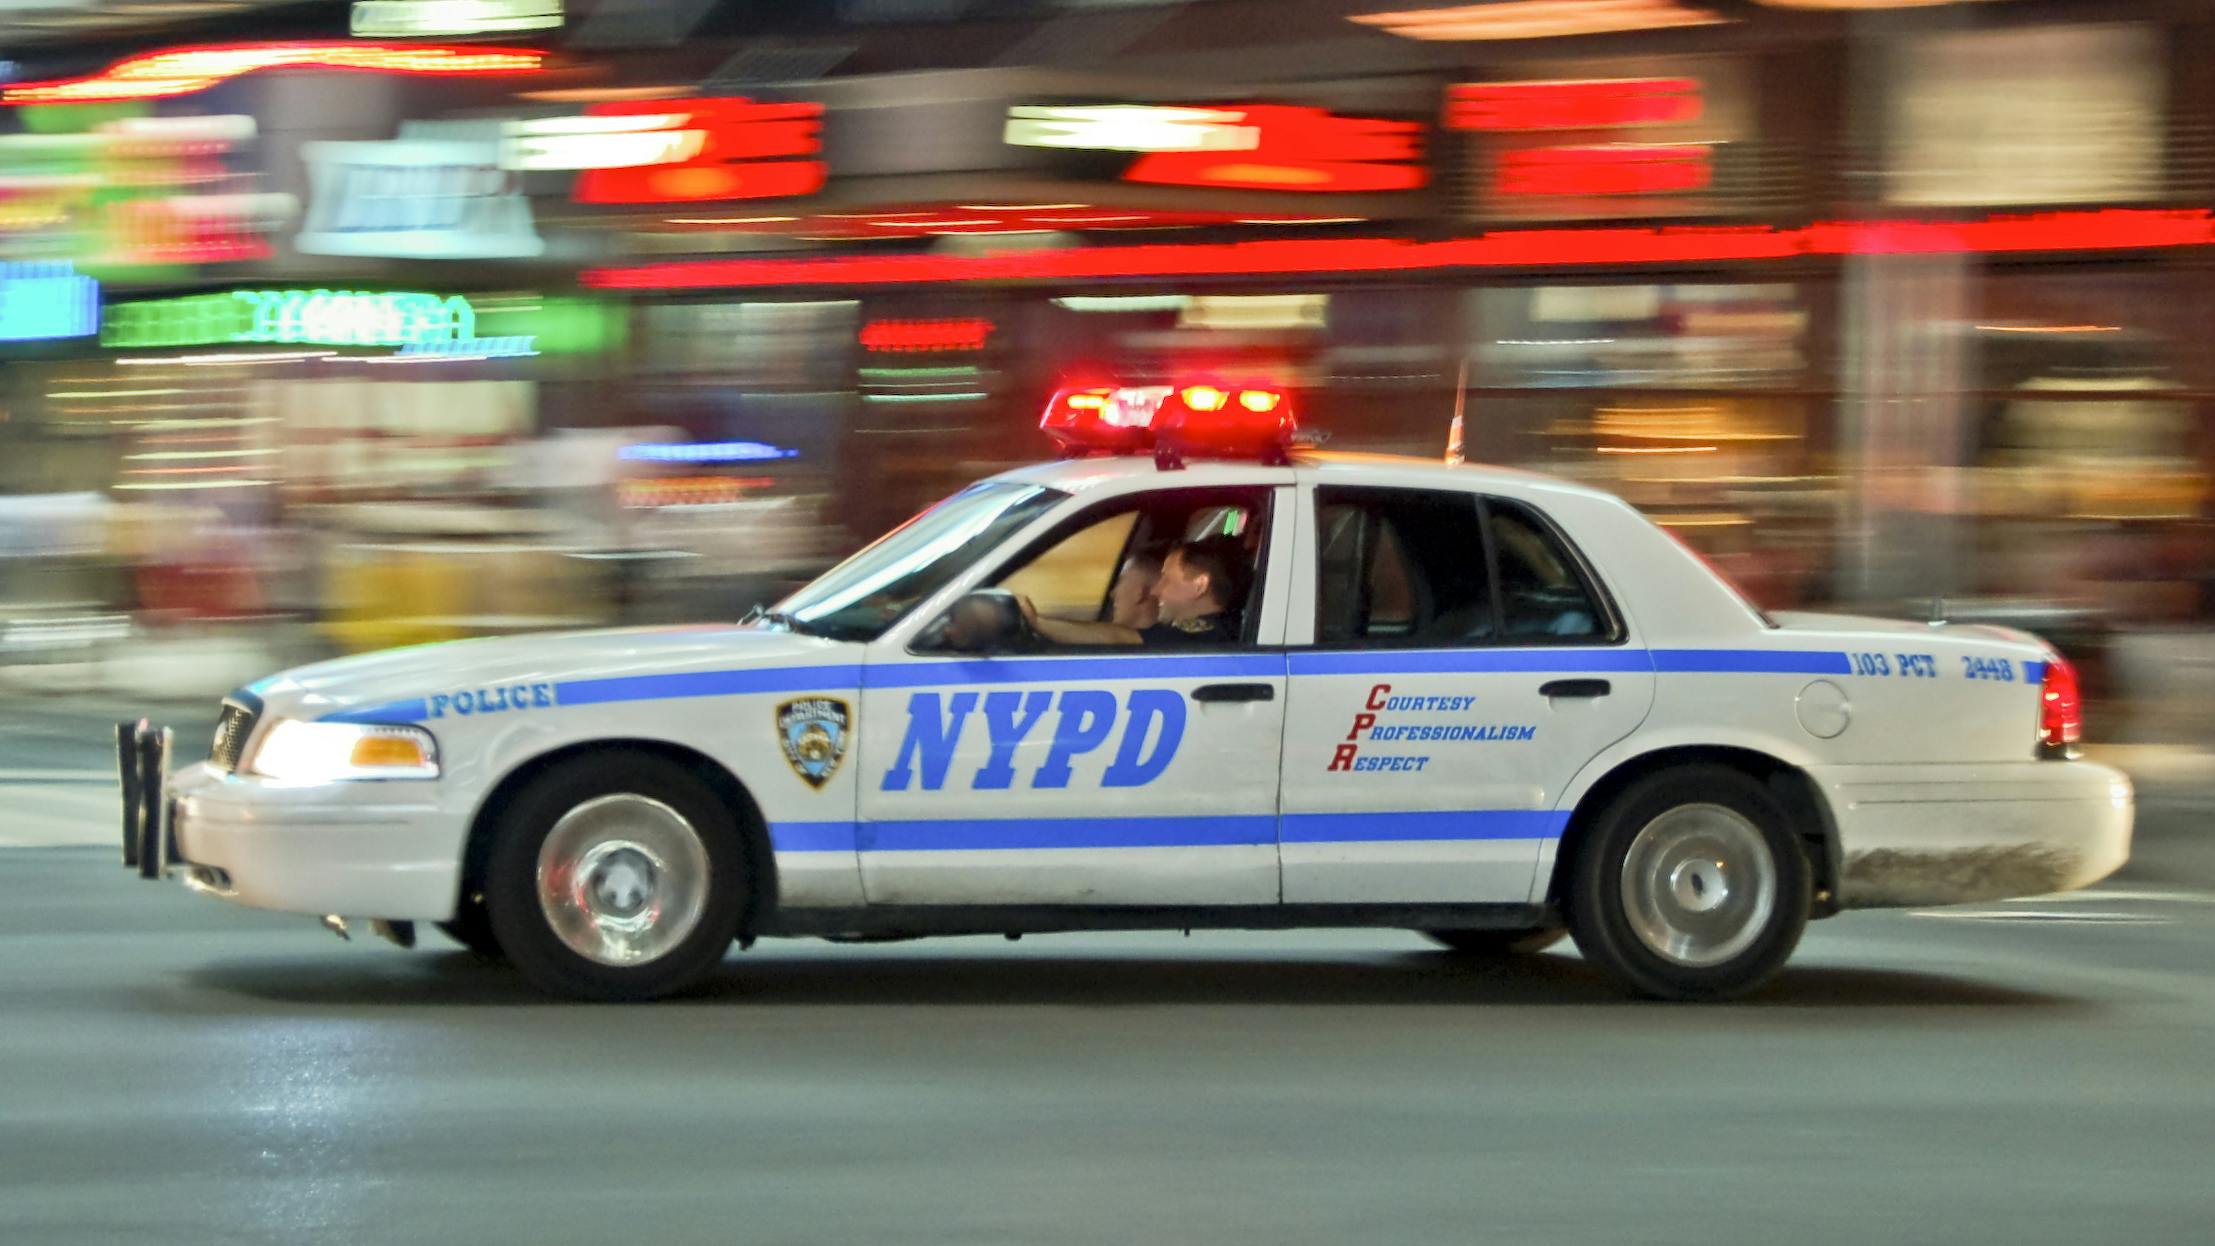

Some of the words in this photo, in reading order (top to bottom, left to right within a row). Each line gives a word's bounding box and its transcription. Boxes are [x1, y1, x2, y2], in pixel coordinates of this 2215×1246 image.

[1852, 652, 1890, 676] 103
[1895, 653, 1937, 678] PCT
[1961, 655, 2014, 682] 2448
[430, 683, 551, 718] POLICE
[1366, 683, 1475, 711] COURTESY
[879, 688, 1187, 791] NYPD
[1346, 713, 1536, 741] PROFESSIONALISM
[1327, 743, 1429, 772] RESPECT
